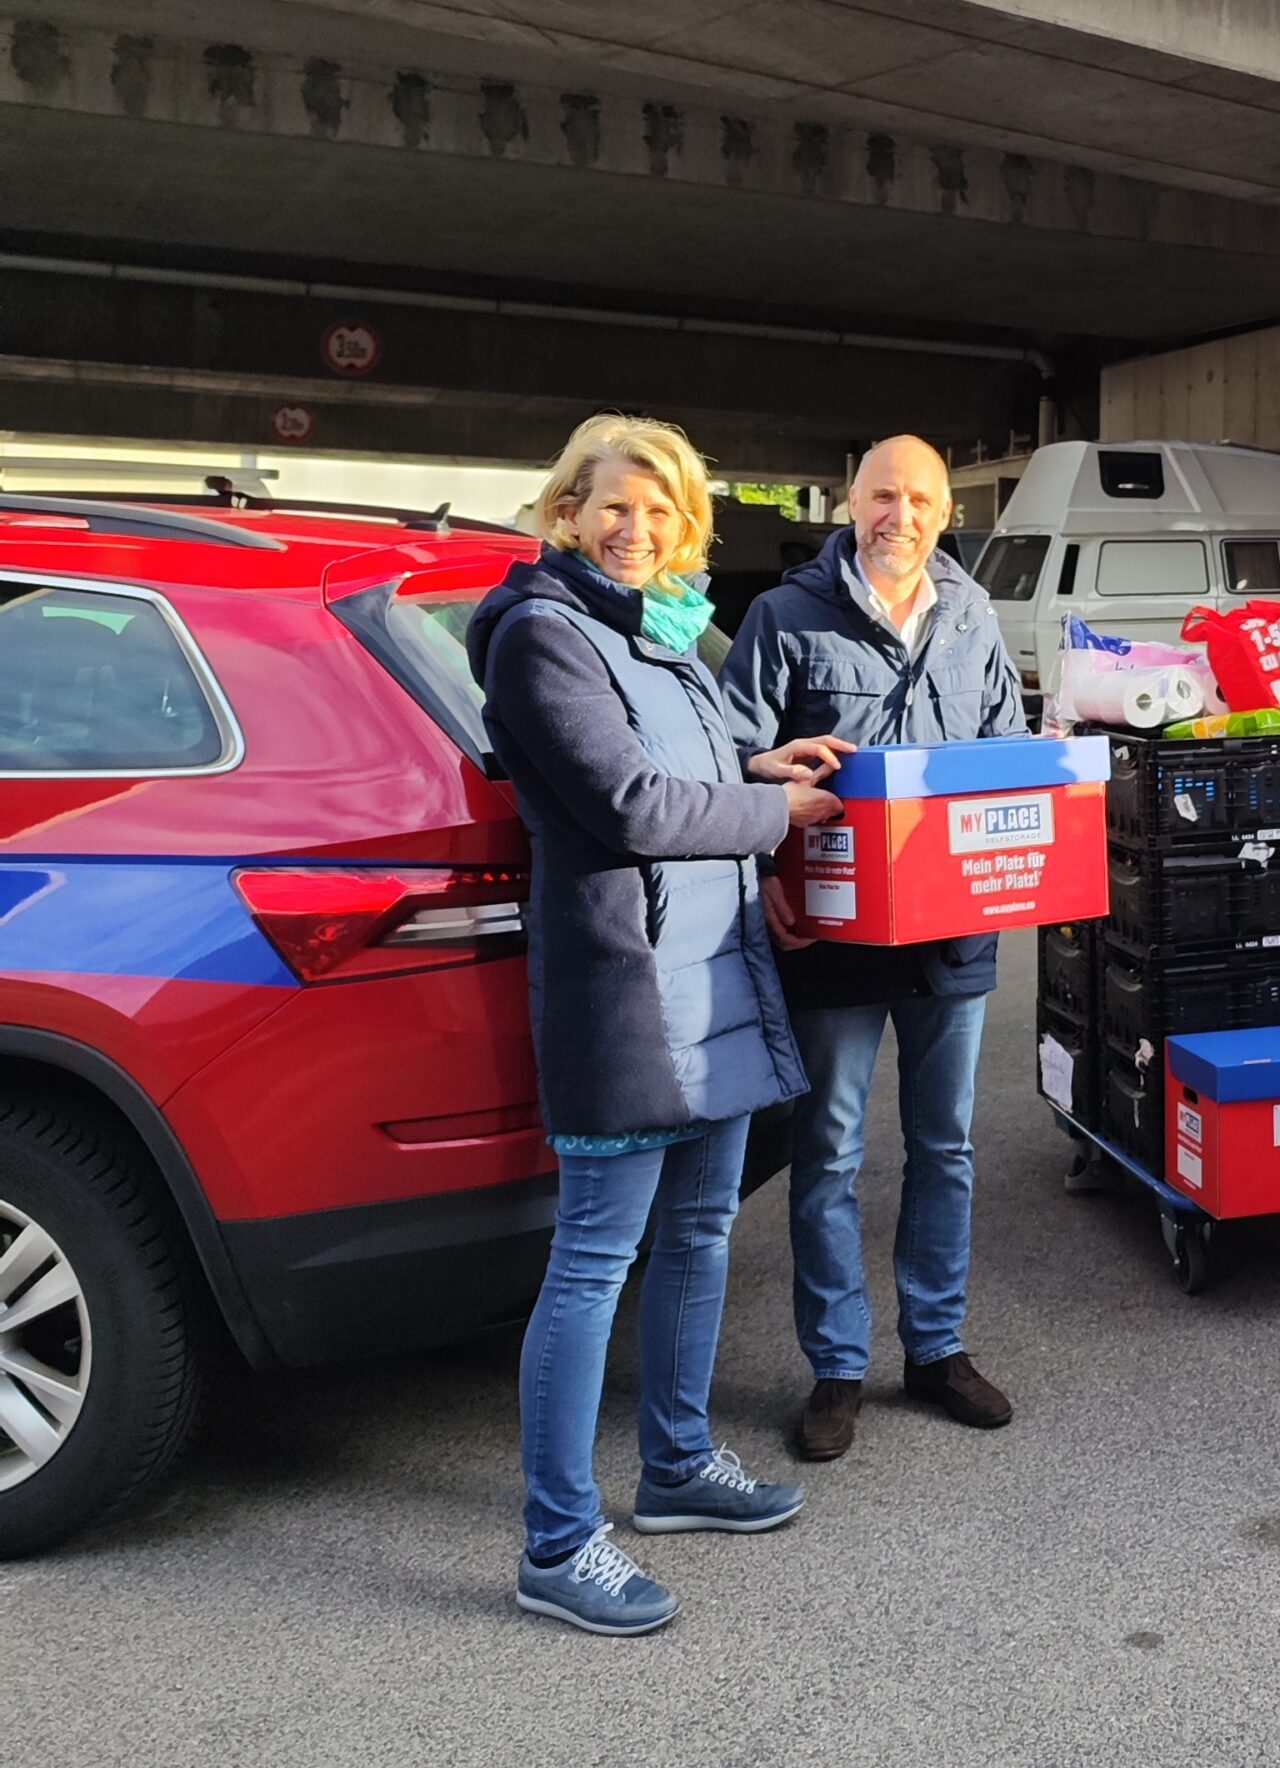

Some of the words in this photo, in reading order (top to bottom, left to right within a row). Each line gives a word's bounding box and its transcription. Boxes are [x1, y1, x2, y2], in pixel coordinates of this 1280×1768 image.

[1259, 654, 1280, 672] zu
[960, 812, 982, 834] MY
[984, 806, 1040, 833] PLACE
[821, 833, 848, 850] PLACE
[962, 858, 992, 877] Mein
[994, 853, 1025, 872] Platz
[1026, 850, 1046, 869] für
[970, 875, 1004, 896] mehr
